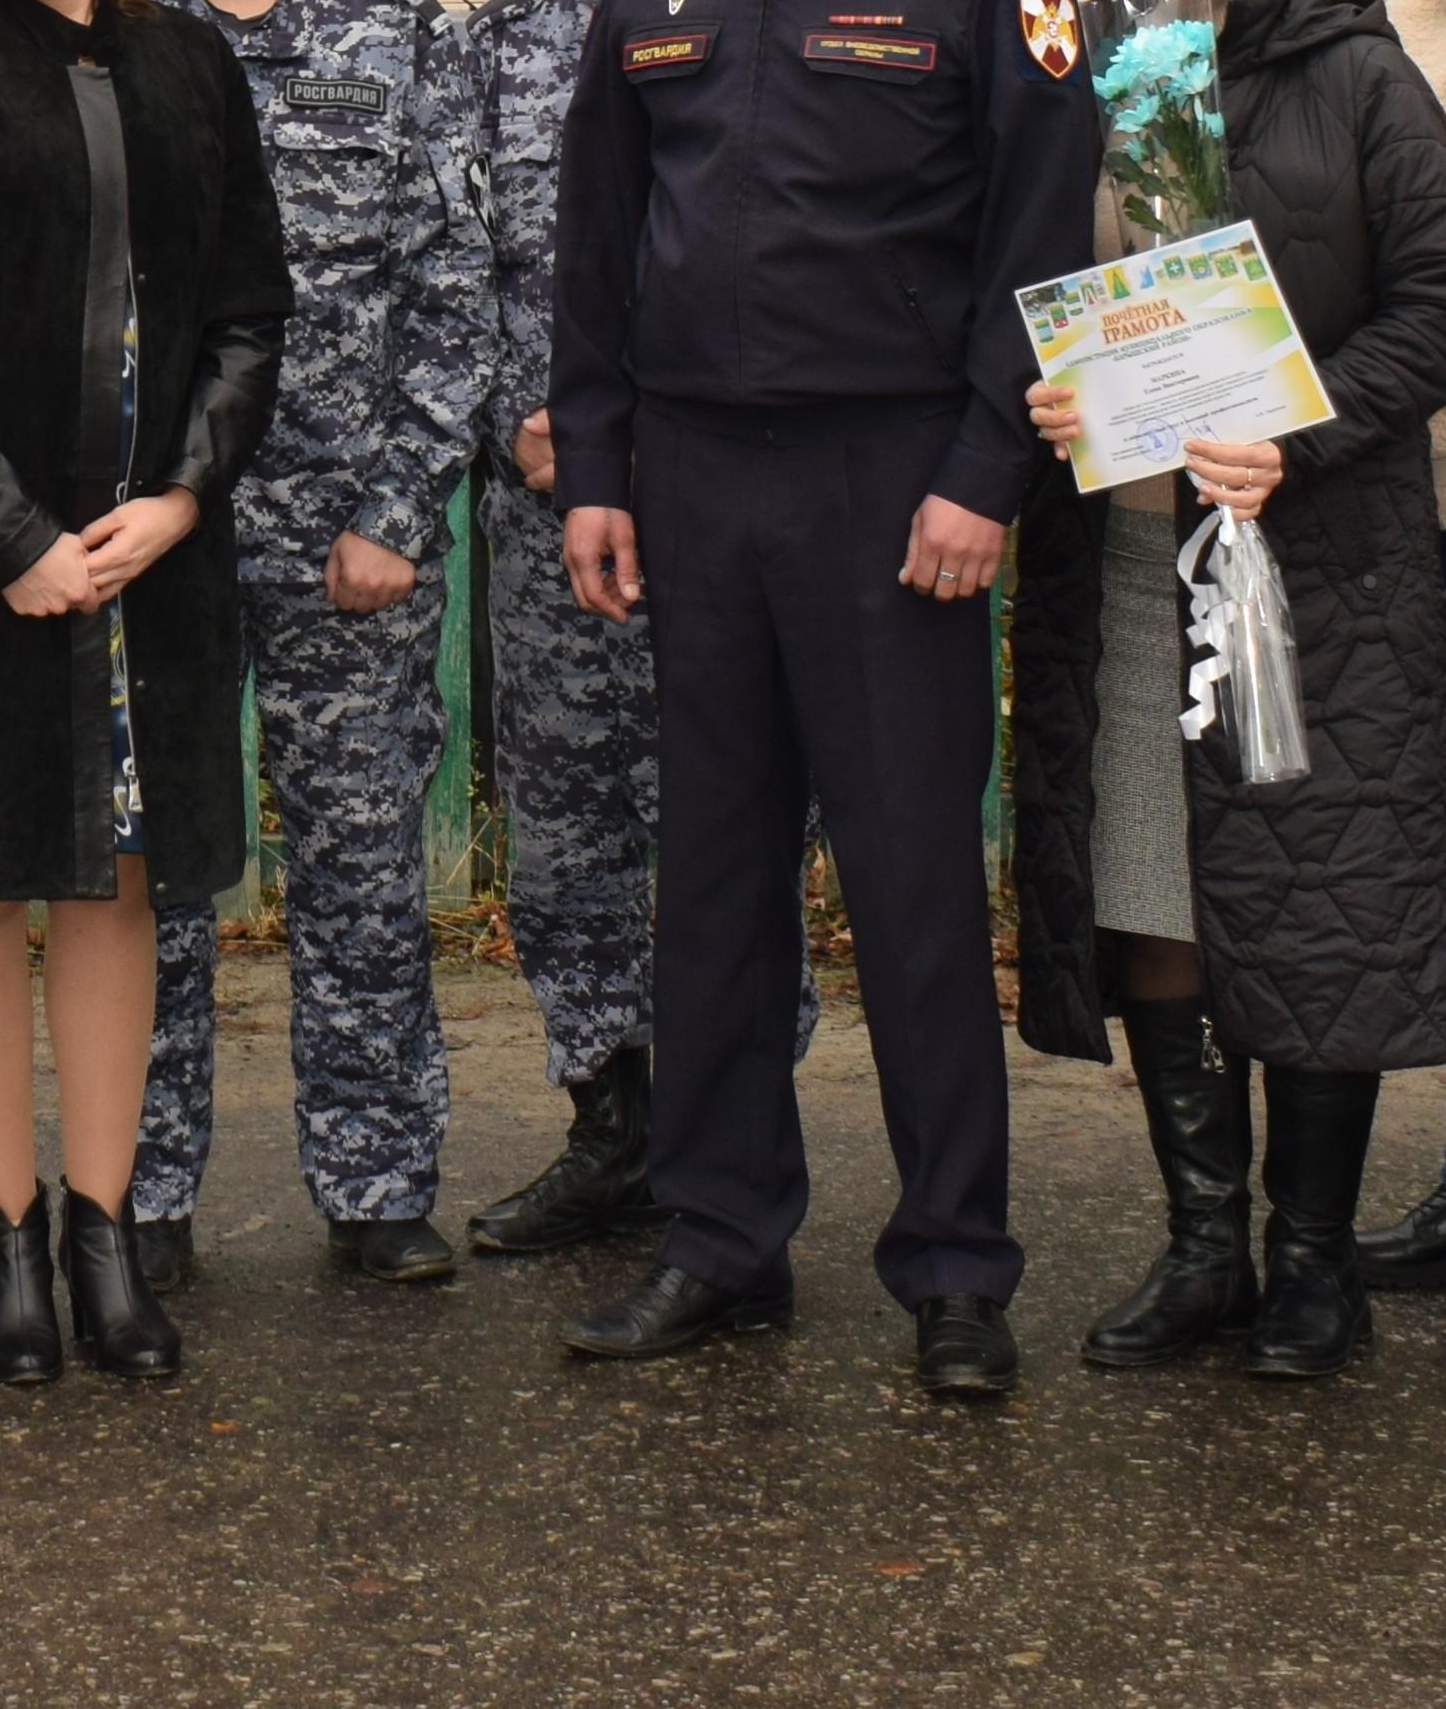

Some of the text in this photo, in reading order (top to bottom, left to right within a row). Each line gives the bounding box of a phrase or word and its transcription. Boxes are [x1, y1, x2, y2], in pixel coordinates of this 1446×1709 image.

[632, 42, 692, 62] РОСГВАРДИЯ
[294, 83, 378, 105] РОСГВАРДИЯ
[1102, 298, 1170, 328] ПОЧЁТНАЯ
[1102, 309, 1187, 344] ГРАМОТА
